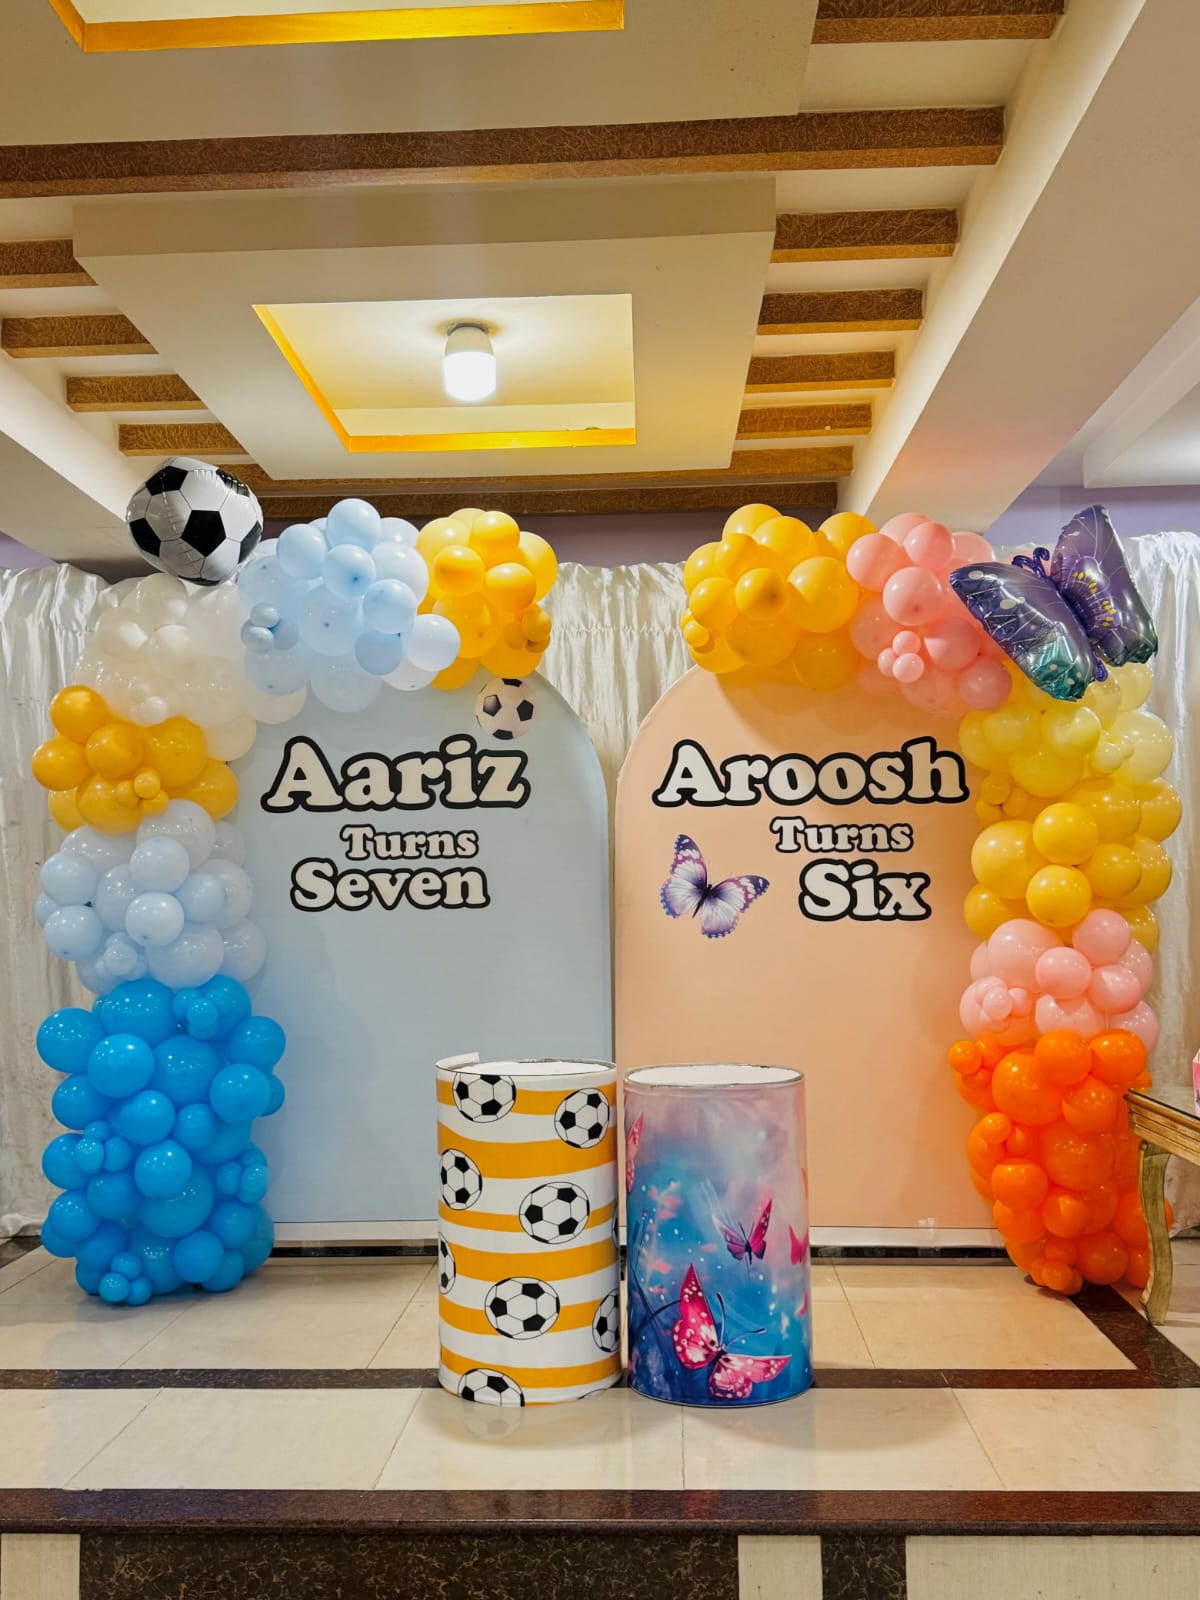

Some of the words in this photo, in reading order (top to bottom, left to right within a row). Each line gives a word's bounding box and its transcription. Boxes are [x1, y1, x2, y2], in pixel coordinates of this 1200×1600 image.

[260, 734, 531, 813] Aariz
[651, 736, 970, 806] Aroosh
[339, 823, 479, 861] Turns
[770, 816, 914, 853] Turns
[290, 857, 491, 912] Seven
[799, 858, 932, 921] Six
